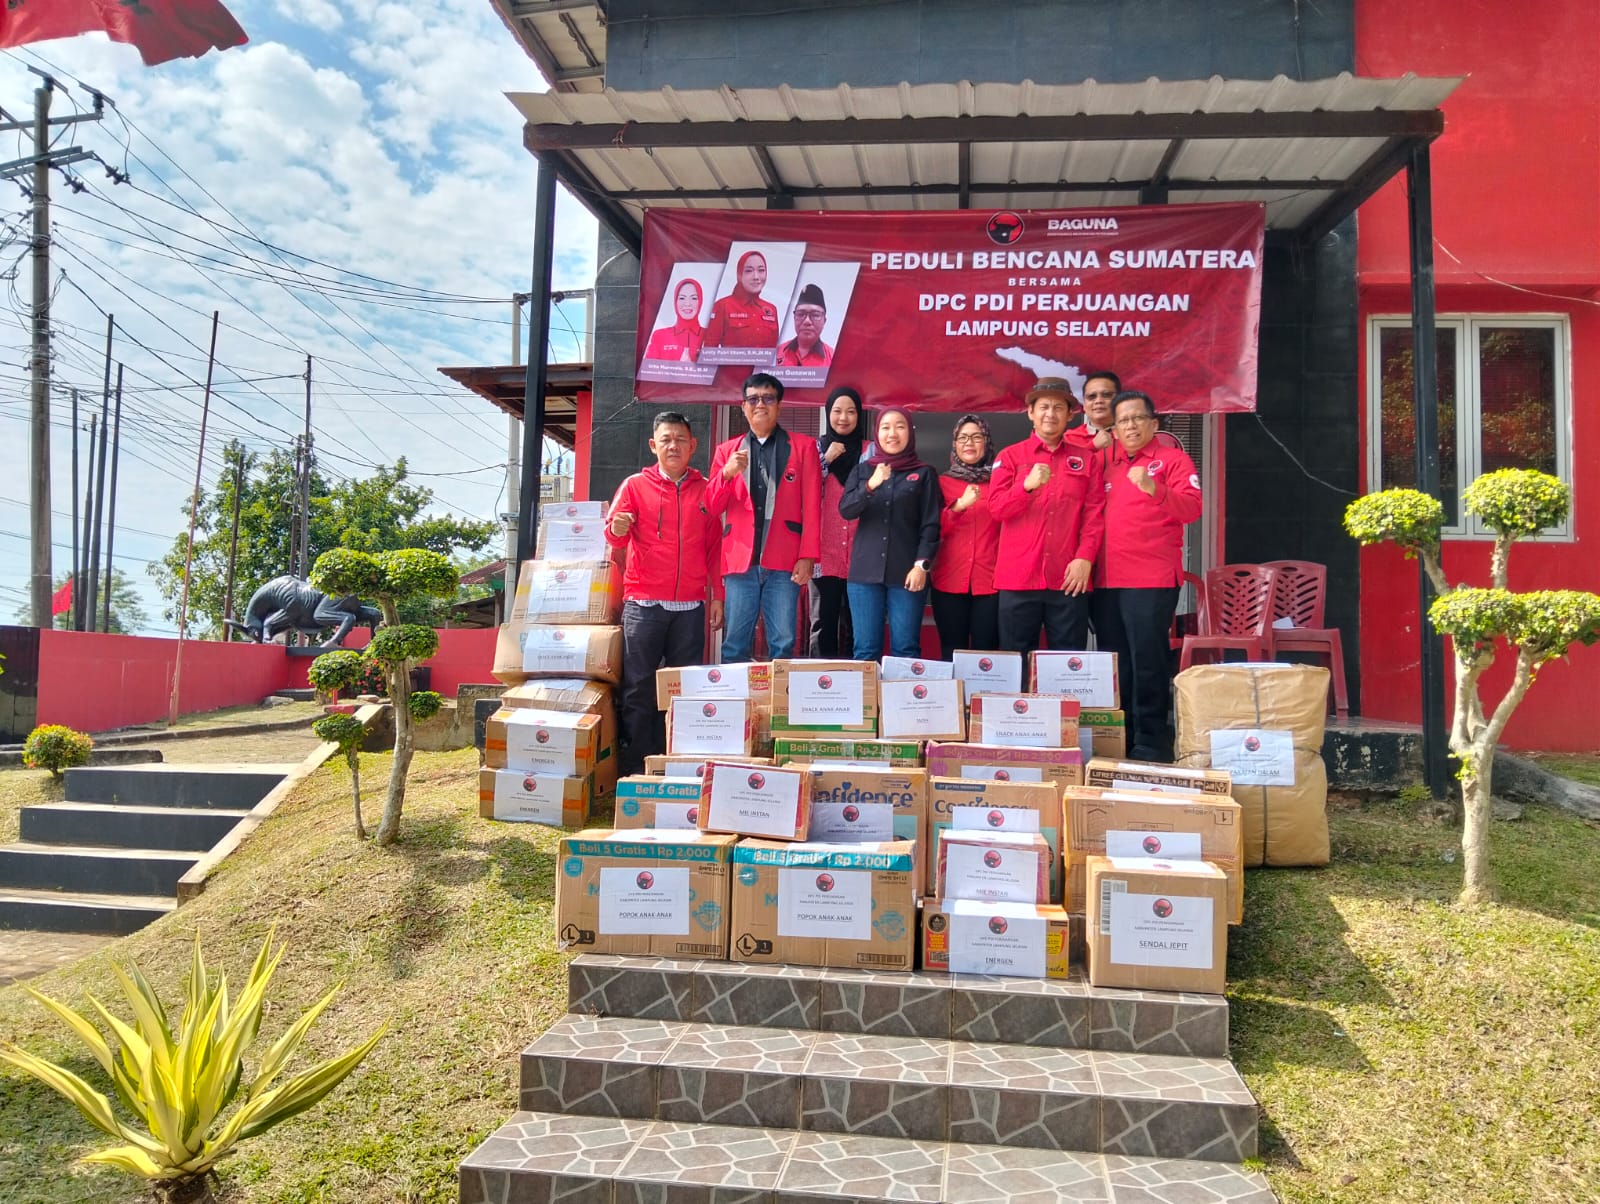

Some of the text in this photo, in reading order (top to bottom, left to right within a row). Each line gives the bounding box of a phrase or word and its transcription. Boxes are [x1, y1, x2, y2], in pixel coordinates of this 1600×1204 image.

[1047, 218, 1119, 230] BAGUNA
[871, 250, 1256, 270] PEDULI BENCANA SUMATERA
[1008, 278, 1081, 286] BERSAMA
[918, 294, 1190, 312] DPC PDI PERJUANGAN
[945, 320, 1150, 337] LAMPUNG SELATAN
[790, 744, 808, 752] Beli
[1092, 772, 1114, 780] LIFREE
[635, 784, 698, 796] Beli 5 Gratis
[815, 782, 914, 808] nfidence
[579, 843, 711, 858] Beli 5 Gratis 1 Rp 2.000
[754, 850, 777, 862] Beli
[779, 852, 786, 862] 5
[835, 856, 852, 868] Rp
[854, 856, 892, 868] 2.000
[567, 927, 576, 940] L
[744, 936, 752, 950] L
[1139, 940, 1188, 950] SENDAL JEPIT
[986, 956, 1014, 965] ENERGEN
